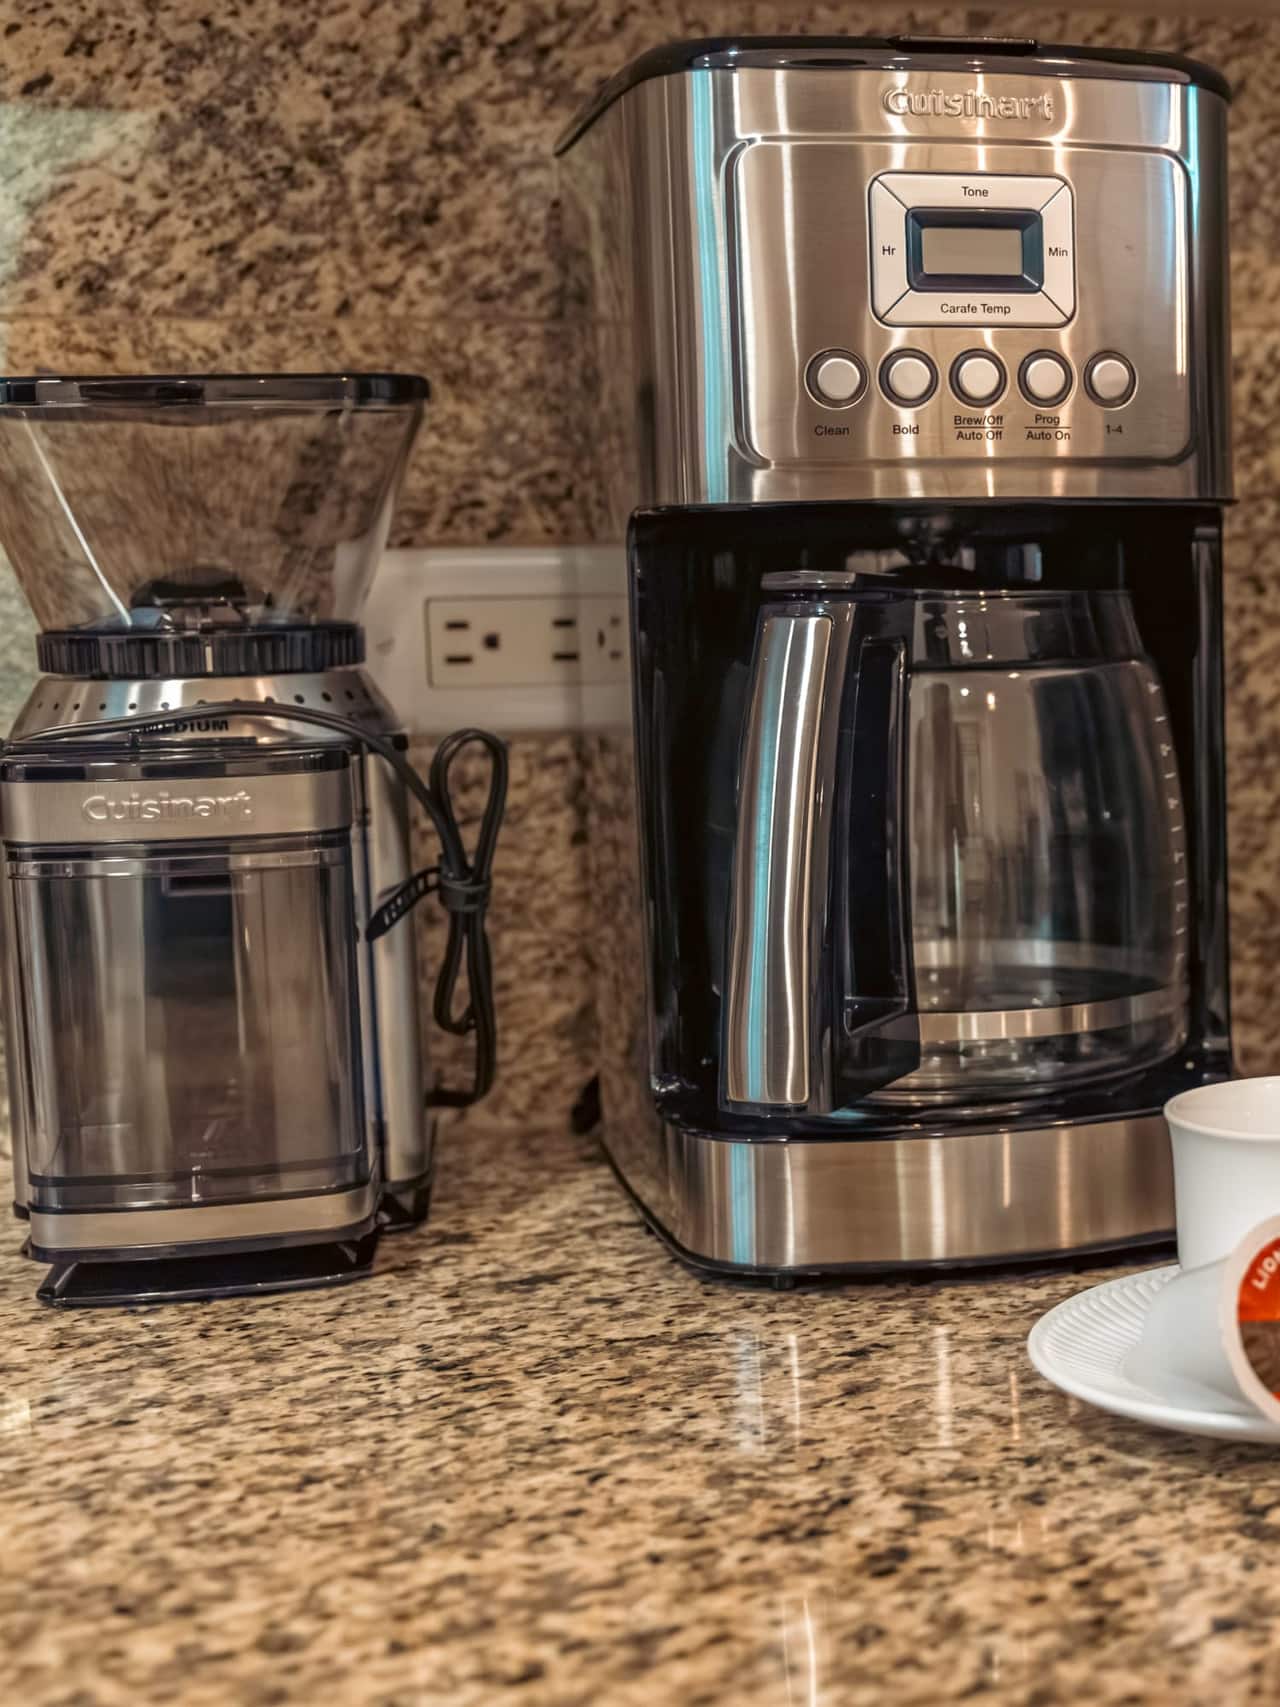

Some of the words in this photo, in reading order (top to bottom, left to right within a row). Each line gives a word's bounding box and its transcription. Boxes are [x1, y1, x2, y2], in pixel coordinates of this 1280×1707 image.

[882, 87, 1054, 121] Cuisinart
[961, 186, 989, 198] Tone
[882, 245, 896, 256] Hr
[1048, 246, 1068, 257] Min
[940, 302, 977, 315] Carafe
[981, 303, 1011, 317] Temp
[953, 415, 1004, 426] Brew/Off
[1034, 414, 1060, 427] Prog
[814, 424, 850, 436] Clean
[892, 424, 919, 435] Bold
[1105, 424, 1123, 435] 1-4
[956, 430, 983, 441] Auto
[985, 430, 1003, 441] Off
[1026, 430, 1050, 441] Auto
[1053, 430, 1071, 441] On
[81, 790, 252, 821] Cuisinart
